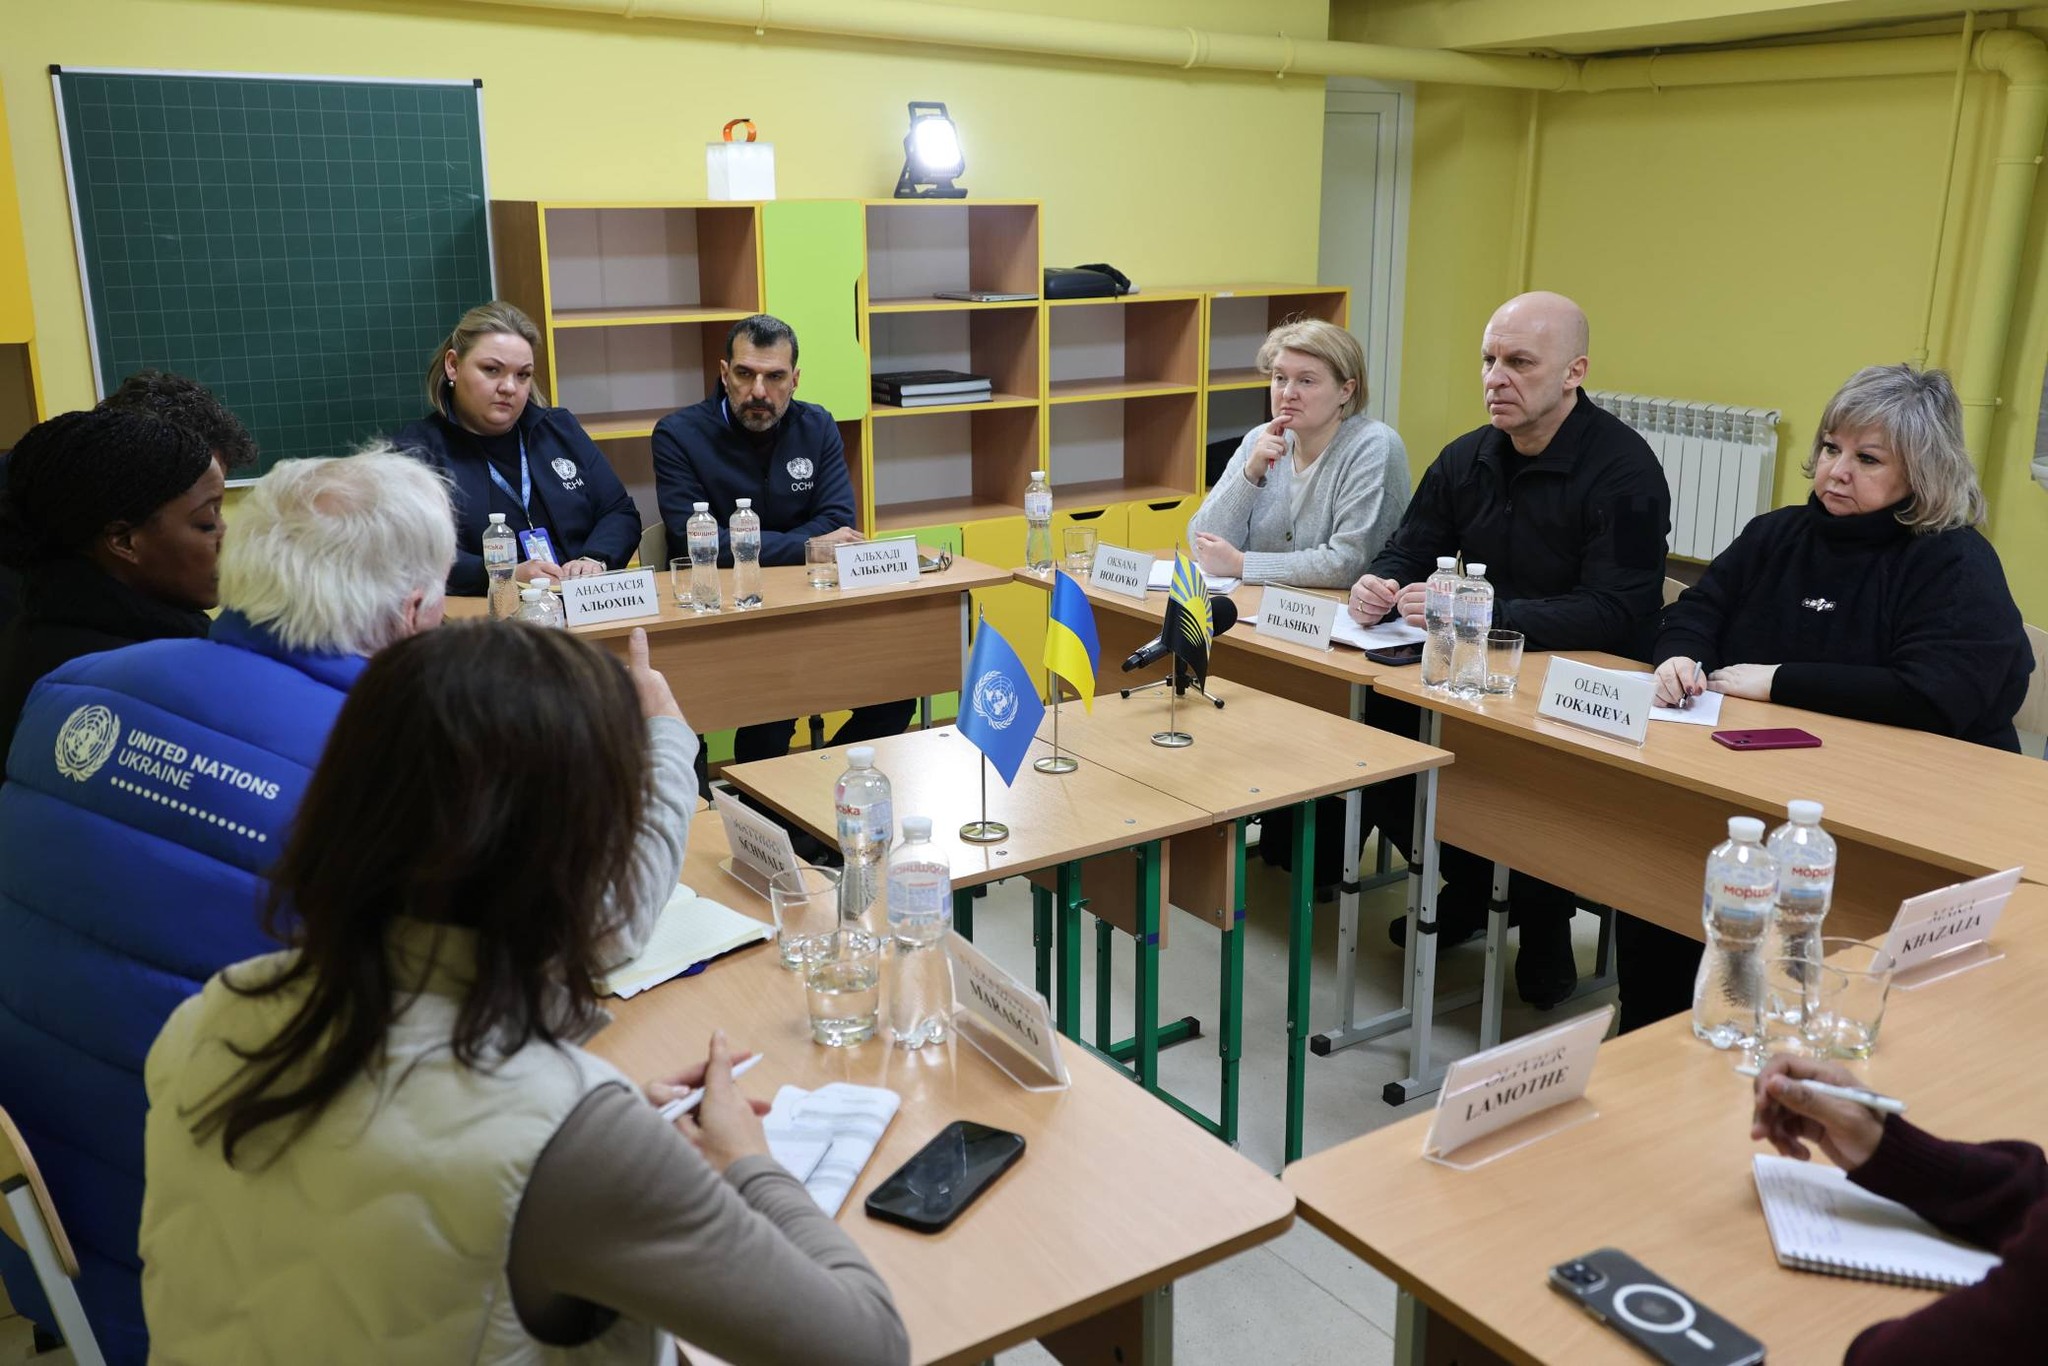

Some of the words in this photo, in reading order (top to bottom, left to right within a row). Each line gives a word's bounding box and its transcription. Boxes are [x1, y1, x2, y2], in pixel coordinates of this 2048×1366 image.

[854, 548, 900, 563] АЛЬХАДІ
[1107, 556, 1137, 572] OKSANA
[850, 562, 908, 577] АЛЬБАРІДІ
[1100, 570, 1138, 588] HOLOVKO
[575, 578, 644, 598] АНАСТАСІЯ
[579, 595, 645, 614] АЛЬОХІНА
[1280, 598, 1316, 617] VADYM
[1267, 613, 1321, 635] FILASHKIN
[1574, 677, 1620, 701] OLENA
[1555, 692, 1631, 726] TOKAREVA
[118, 748, 195, 791] UKRAINE
[127, 729, 188, 764] UNITED
[191, 754, 280, 800] NATIONS
[1902, 914, 1981, 954] KHAZALIA
[969, 978, 1039, 1046] MARASCO
[1465, 1066, 1570, 1122] LAMOTHE
